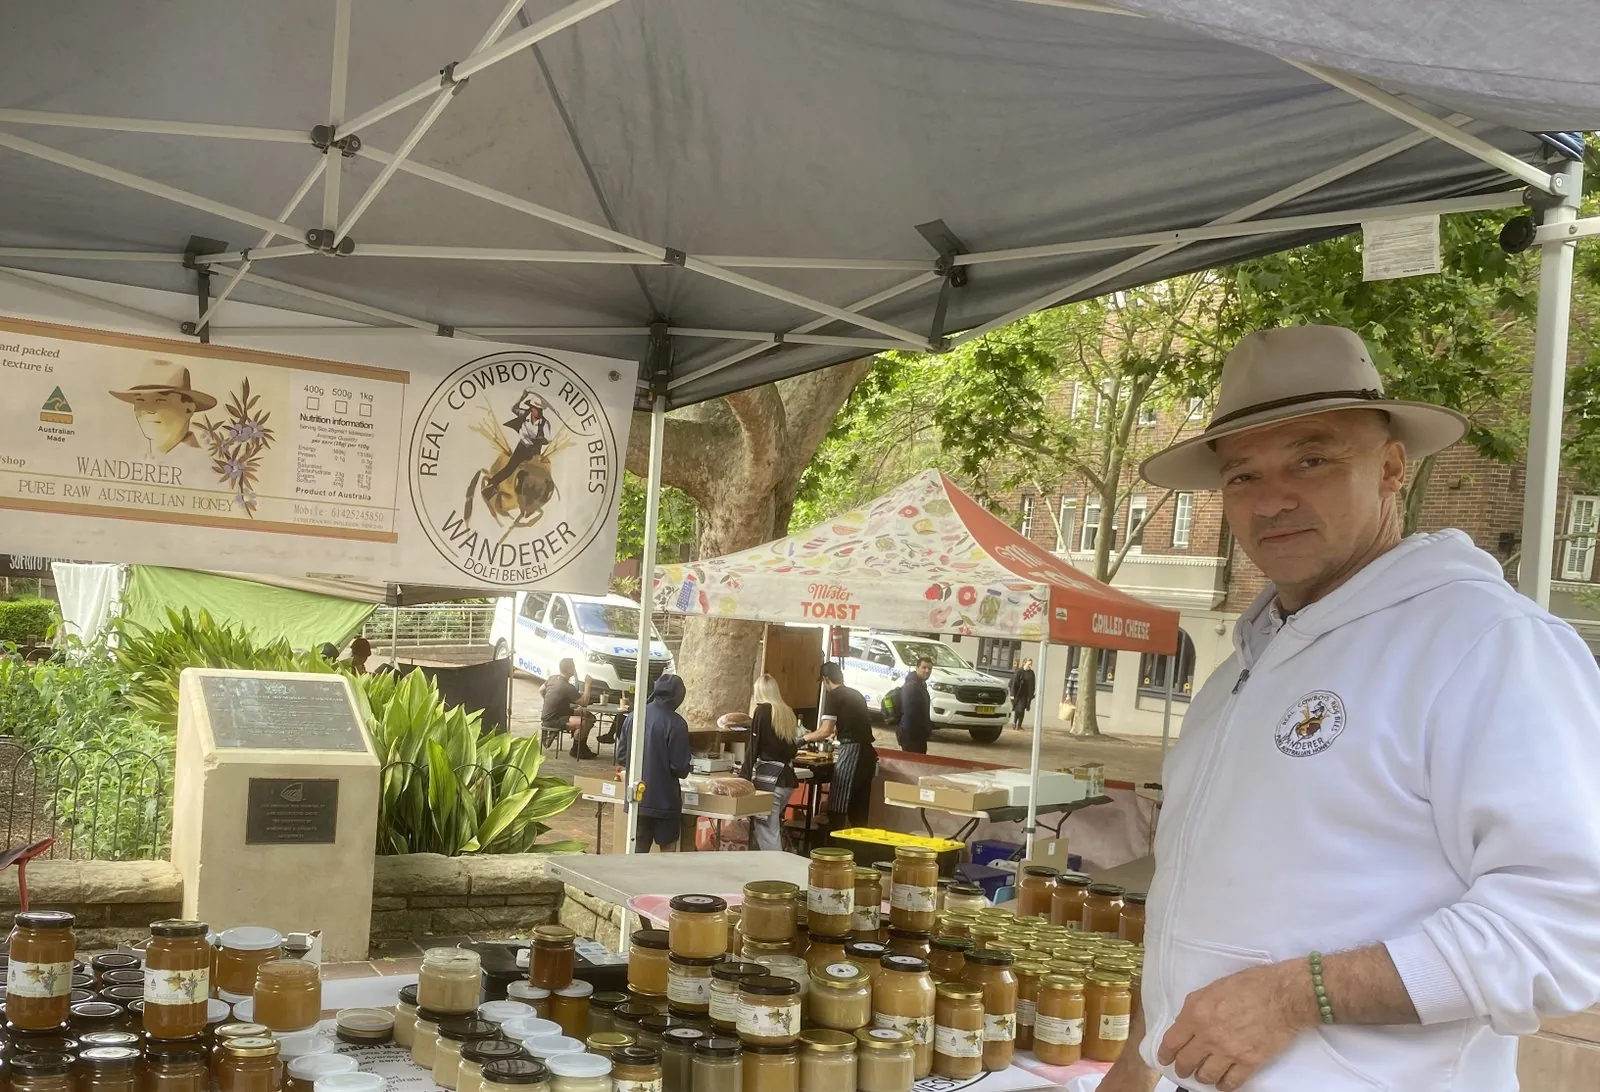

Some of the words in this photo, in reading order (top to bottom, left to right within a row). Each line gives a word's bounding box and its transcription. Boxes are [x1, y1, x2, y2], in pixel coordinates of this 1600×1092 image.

[22, 345, 60, 358] packed
[2, 359, 42, 372] texture
[44, 363, 54, 373] is
[303, 384, 324, 396] 400g
[332, 388, 353, 400] 500g
[360, 392, 374, 402] 1kg
[300, 413, 331, 424] Nutrition
[332, 416, 374, 429] information
[419, 420, 450, 476] REAL
[447, 362, 554, 411] COWBOYS
[558, 381, 597, 431] RIDE
[587, 439, 607, 494] BEES
[37, 425, 75, 436] Australian
[46, 435, 66, 443] Made
[76, 456, 183, 485] WANDERER
[18, 480, 55, 495] PURE
[63, 483, 91, 497] RAW
[98, 487, 185, 507] AUSTRALIAN
[192, 496, 236, 512] HONEY
[295, 487, 326, 496] Product
[338, 491, 372, 501] Australia
[441, 509, 577, 568] WANDERER
[463, 557, 500, 580] DOLFI
[501, 563, 548, 581] BENESH
[807, 583, 853, 601] Mister
[801, 601, 860, 620] TOAST
[1091, 612, 1123, 636] GRILLED
[1124, 618, 1151, 640] CHEESE
[613, 645, 662, 658] Polce
[518, 657, 542, 675] Police
